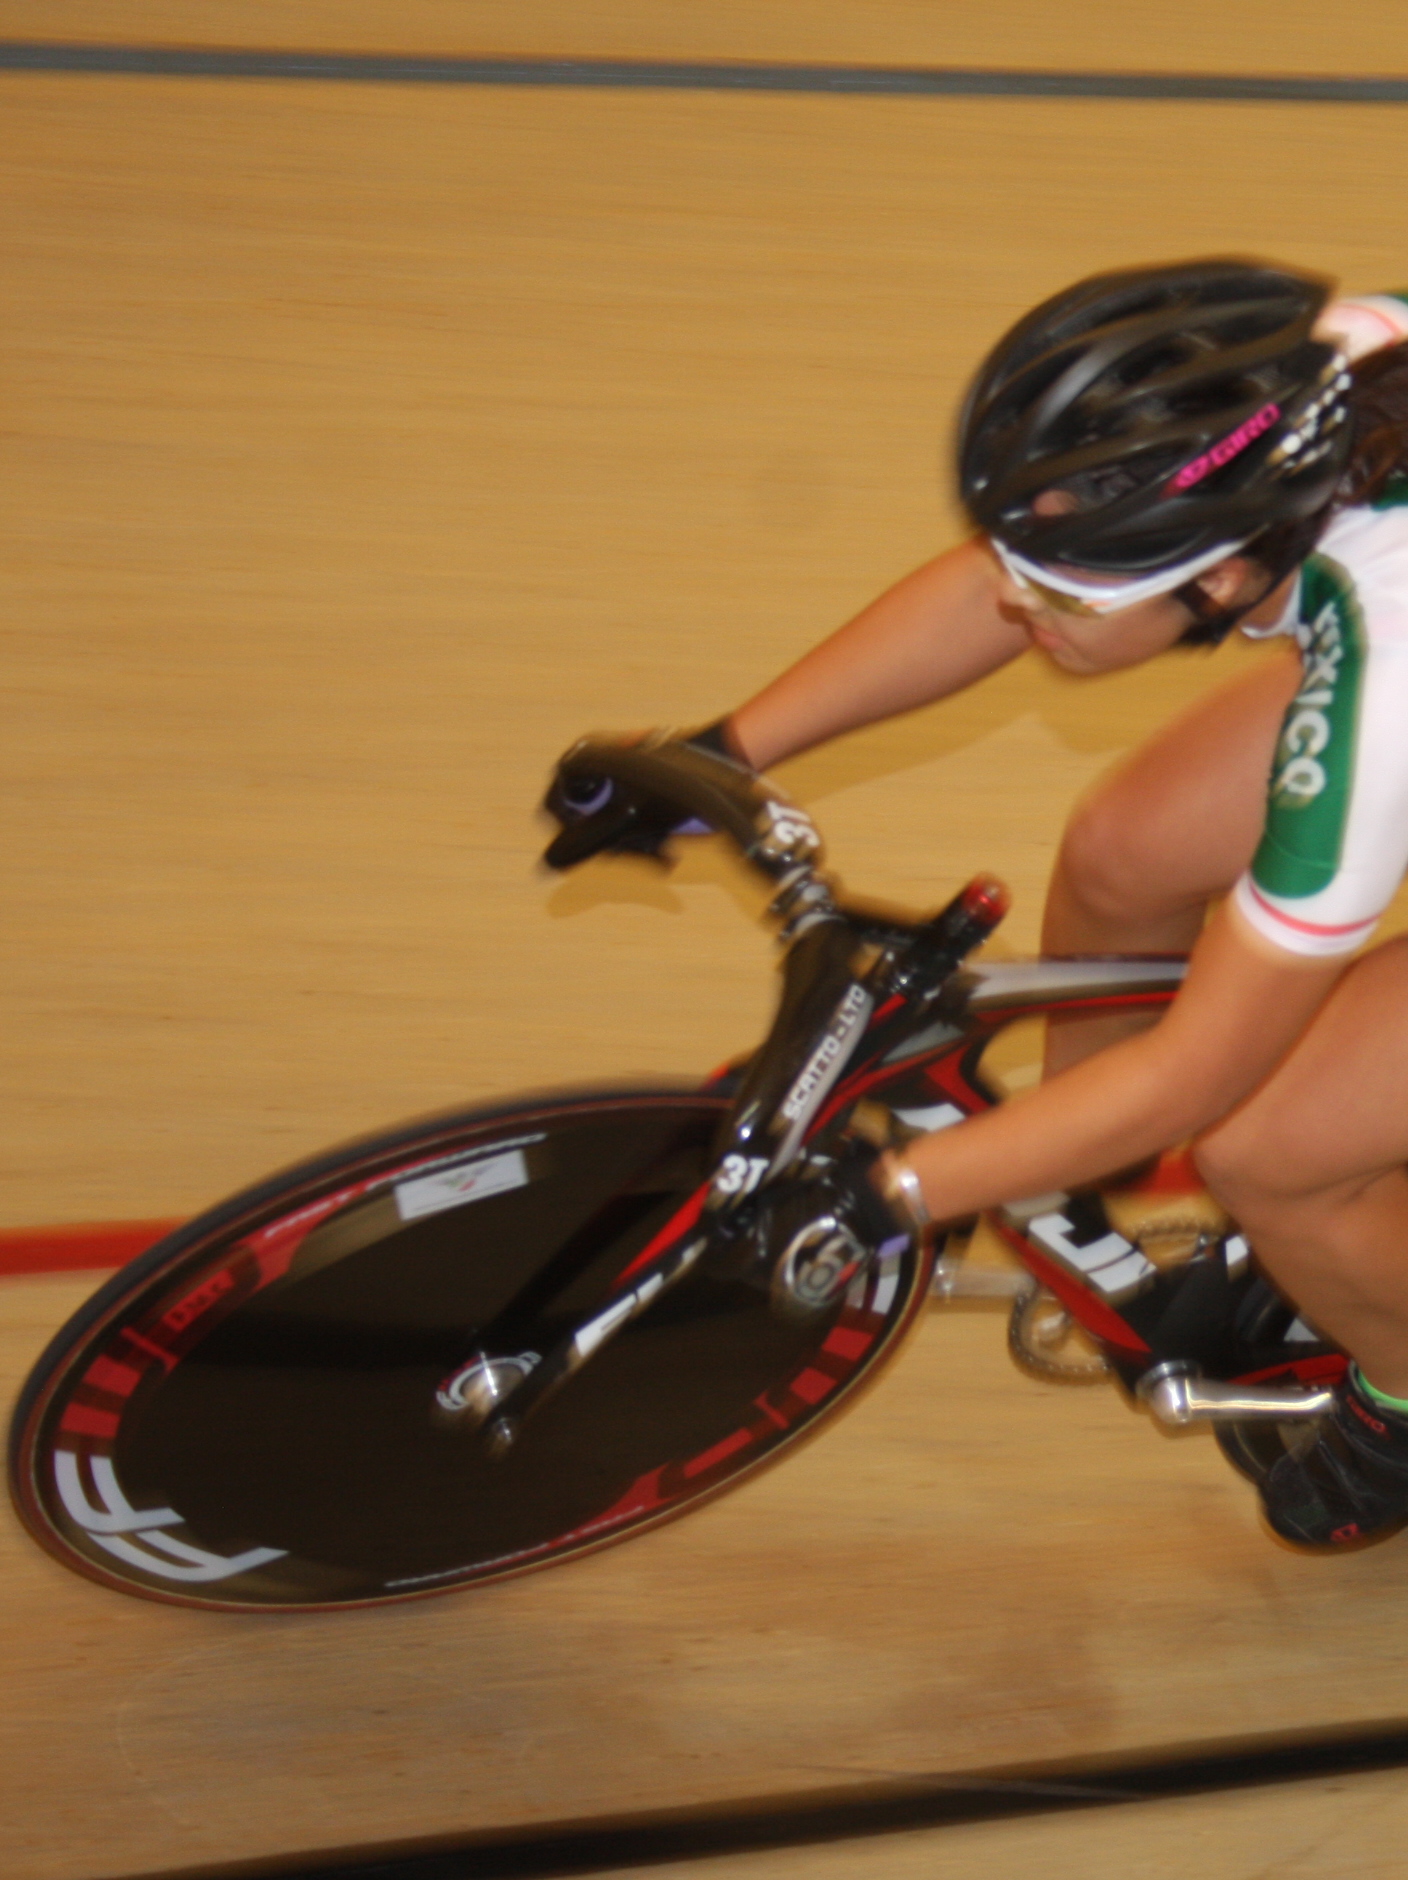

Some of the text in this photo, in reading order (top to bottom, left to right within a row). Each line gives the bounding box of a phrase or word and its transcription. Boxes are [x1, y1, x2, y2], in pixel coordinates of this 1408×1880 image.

[1272, 602, 1343, 798] EXICO
[783, 1034, 842, 1121] SCATTO
[716, 1154, 770, 1194] 3T
